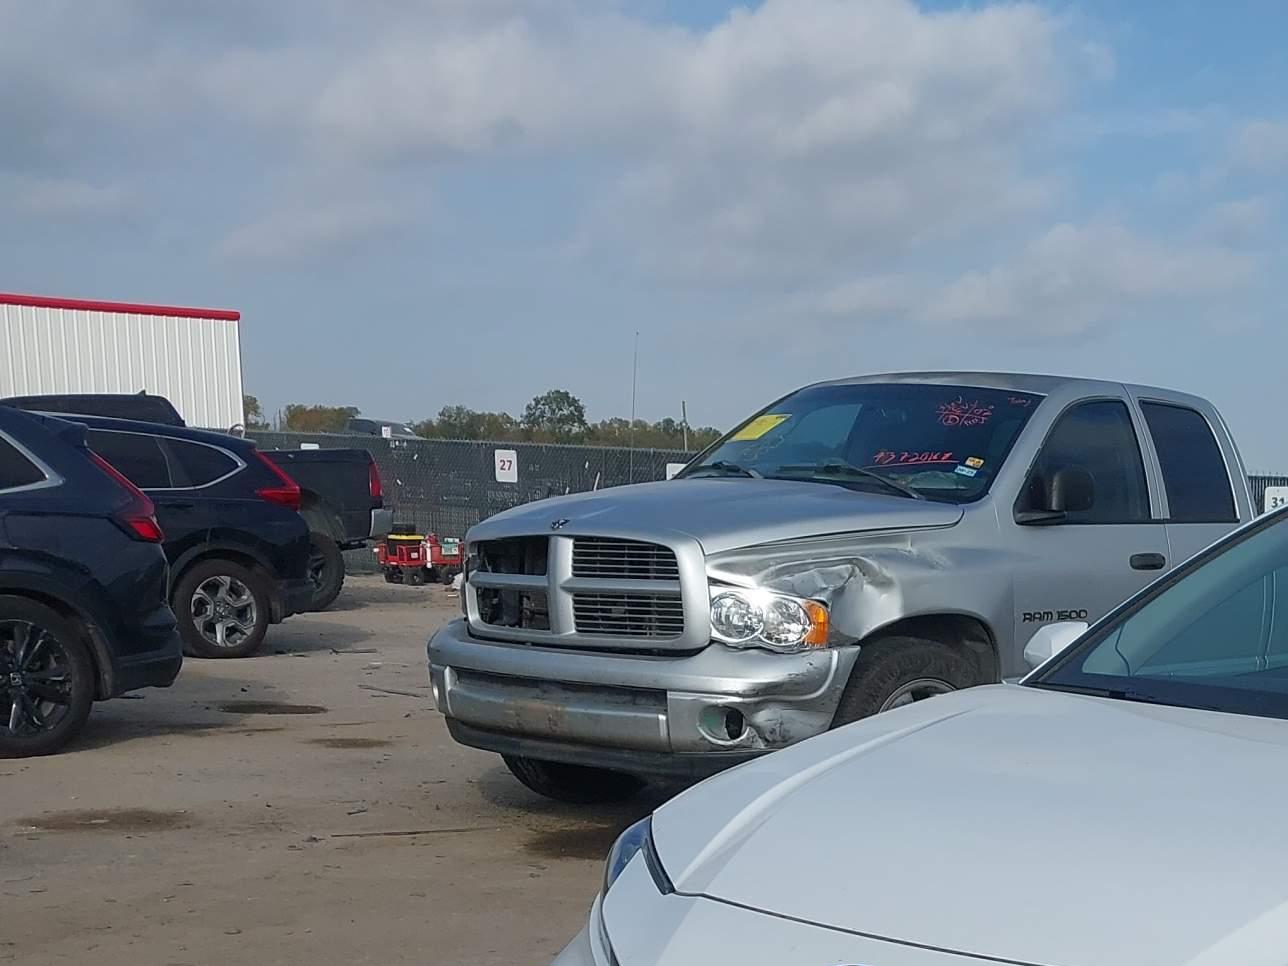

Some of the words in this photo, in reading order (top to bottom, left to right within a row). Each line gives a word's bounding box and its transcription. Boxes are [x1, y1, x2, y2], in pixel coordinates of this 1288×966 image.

[500, 459, 512, 471] 27
[1022, 611, 1054, 623] RAM
[1056, 609, 1088, 621] 1500
